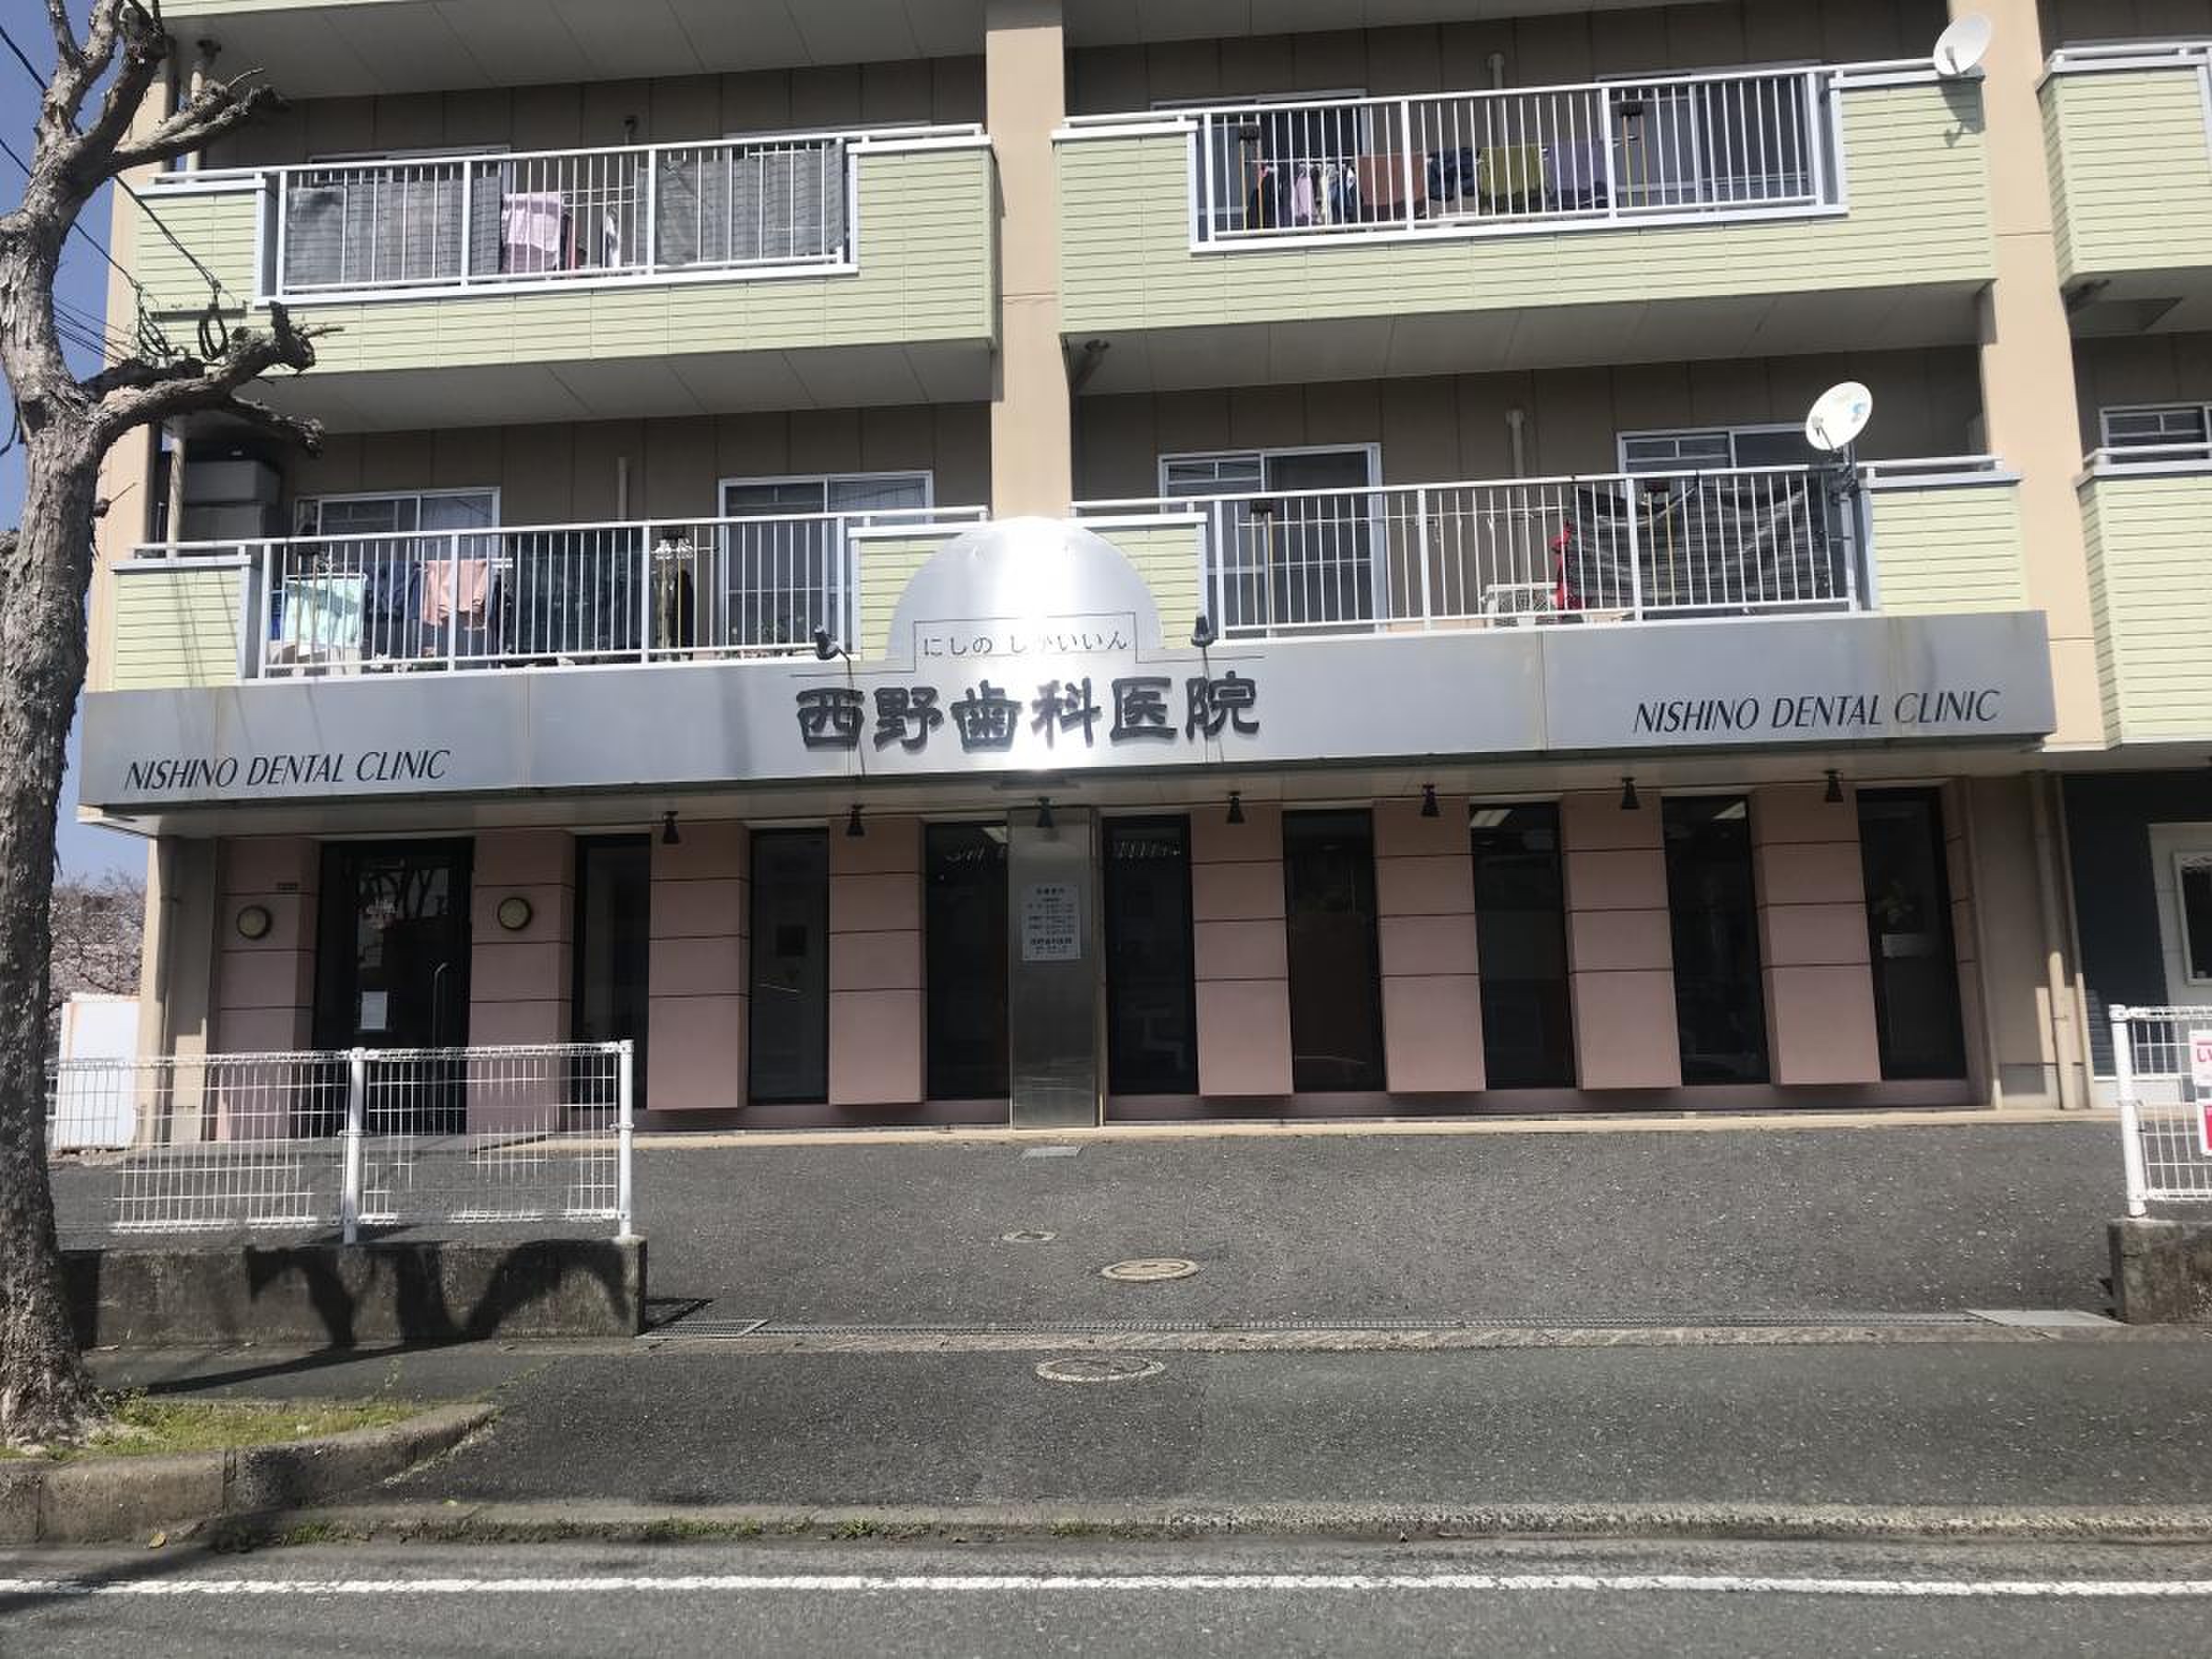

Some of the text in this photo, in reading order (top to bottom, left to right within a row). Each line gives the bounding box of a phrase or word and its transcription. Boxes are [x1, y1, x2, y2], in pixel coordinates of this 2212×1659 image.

[1011, 629, 1128, 653] しいいん
[796, 670, 1261, 754] 西野歯科医院
[1633, 689, 2003, 734] NISHINO DENTAL CLINIC
[125, 749, 451, 791] NISHINO DENTAL CLINIC
